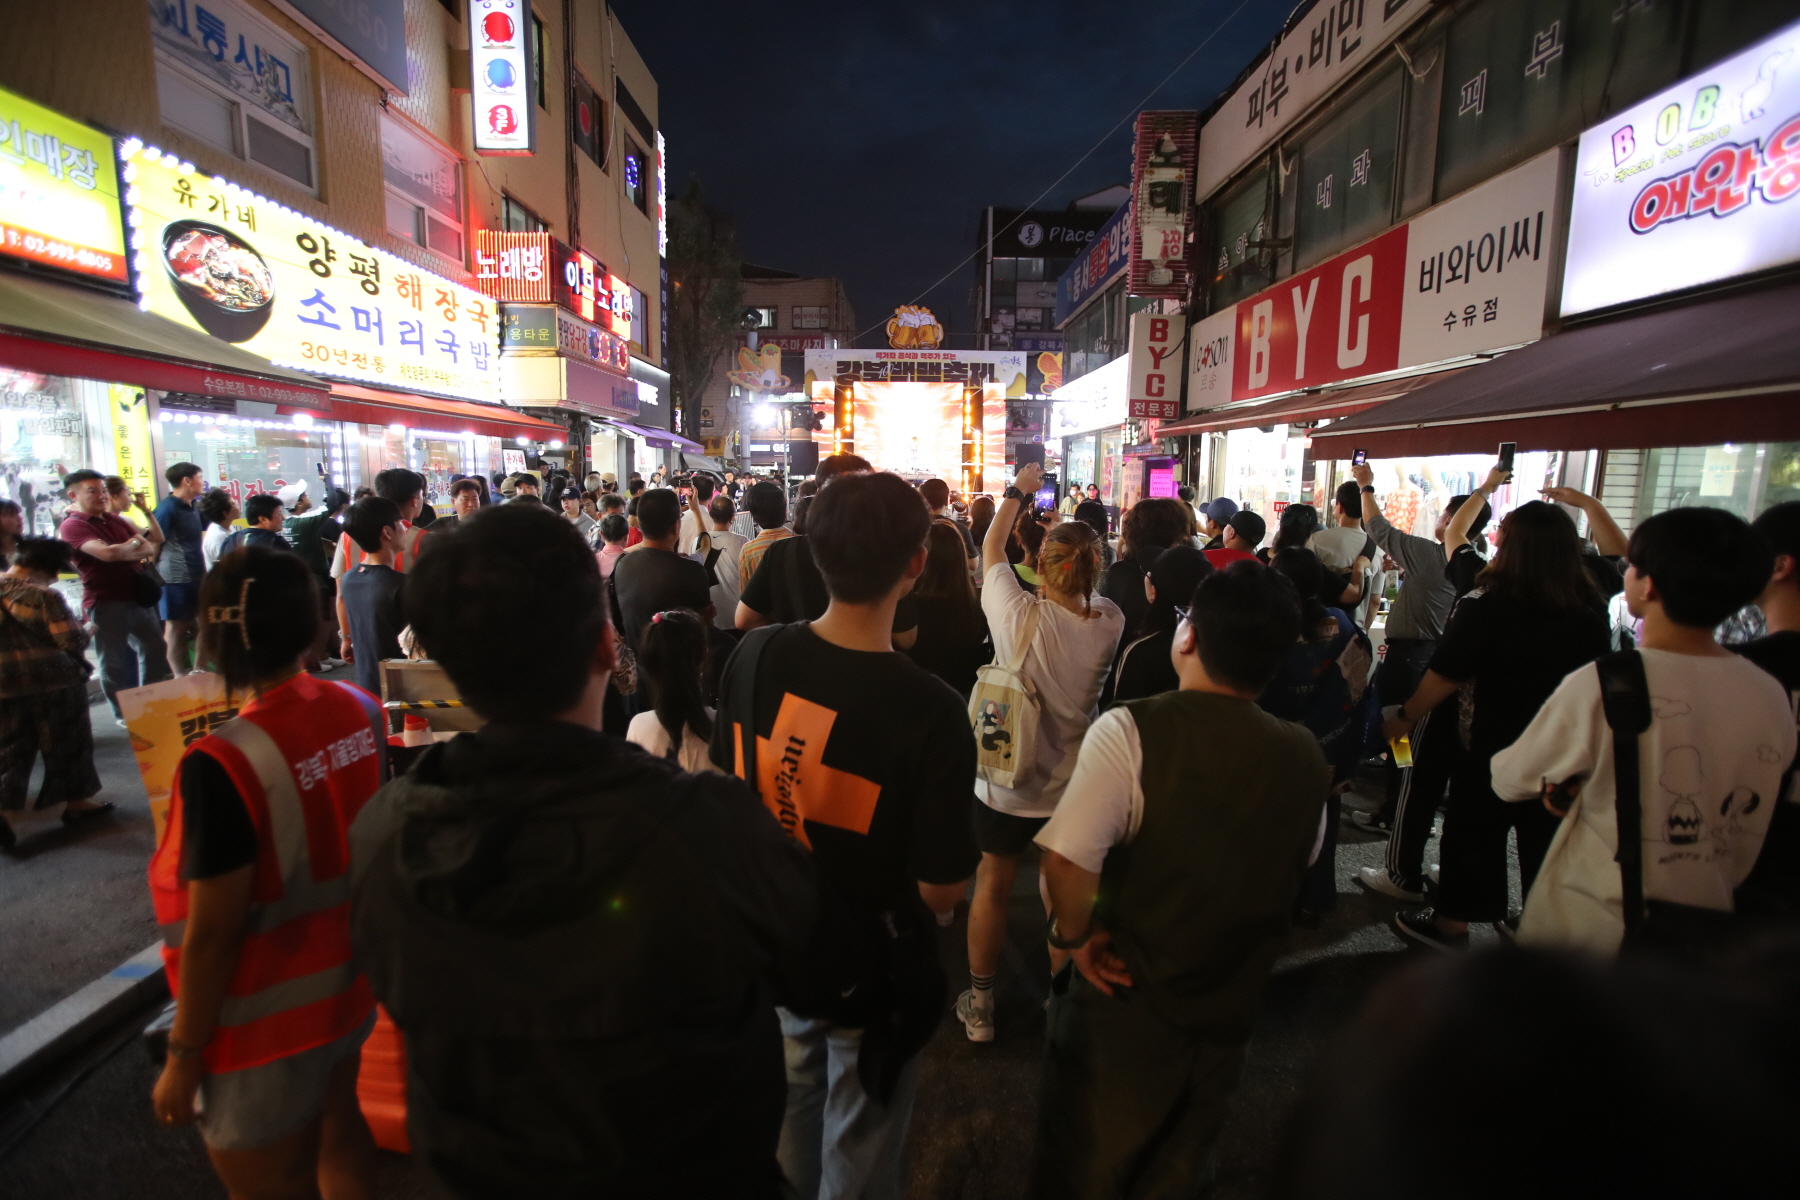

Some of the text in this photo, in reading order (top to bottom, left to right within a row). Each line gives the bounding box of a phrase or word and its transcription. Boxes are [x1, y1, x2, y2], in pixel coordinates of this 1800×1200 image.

[495, 107, 509, 132] 3F
[1611, 84, 1721, 168] BOB
[1614, 154, 1655, 182] Special
[1660, 144, 1683, 164] Pet
[172, 178, 257, 232] 유가네
[1049, 227, 1096, 242] Place
[1419, 210, 1544, 294] 비와이씨
[476, 246, 543, 281] 노래방
[296, 288, 491, 371] 소머리국밥
[1248, 254, 1373, 390] BYC
[1443, 297, 1498, 332] 수유점
[301, 341, 386, 374] 30년전통
[1145, 318, 1169, 397] BYC
[204, 376, 246, 397] 수유본점
[259, 386, 320, 405] 02-993-6805
[1134, 402, 1175, 417] 전문점
[295, 750, 328, 791] 강북
